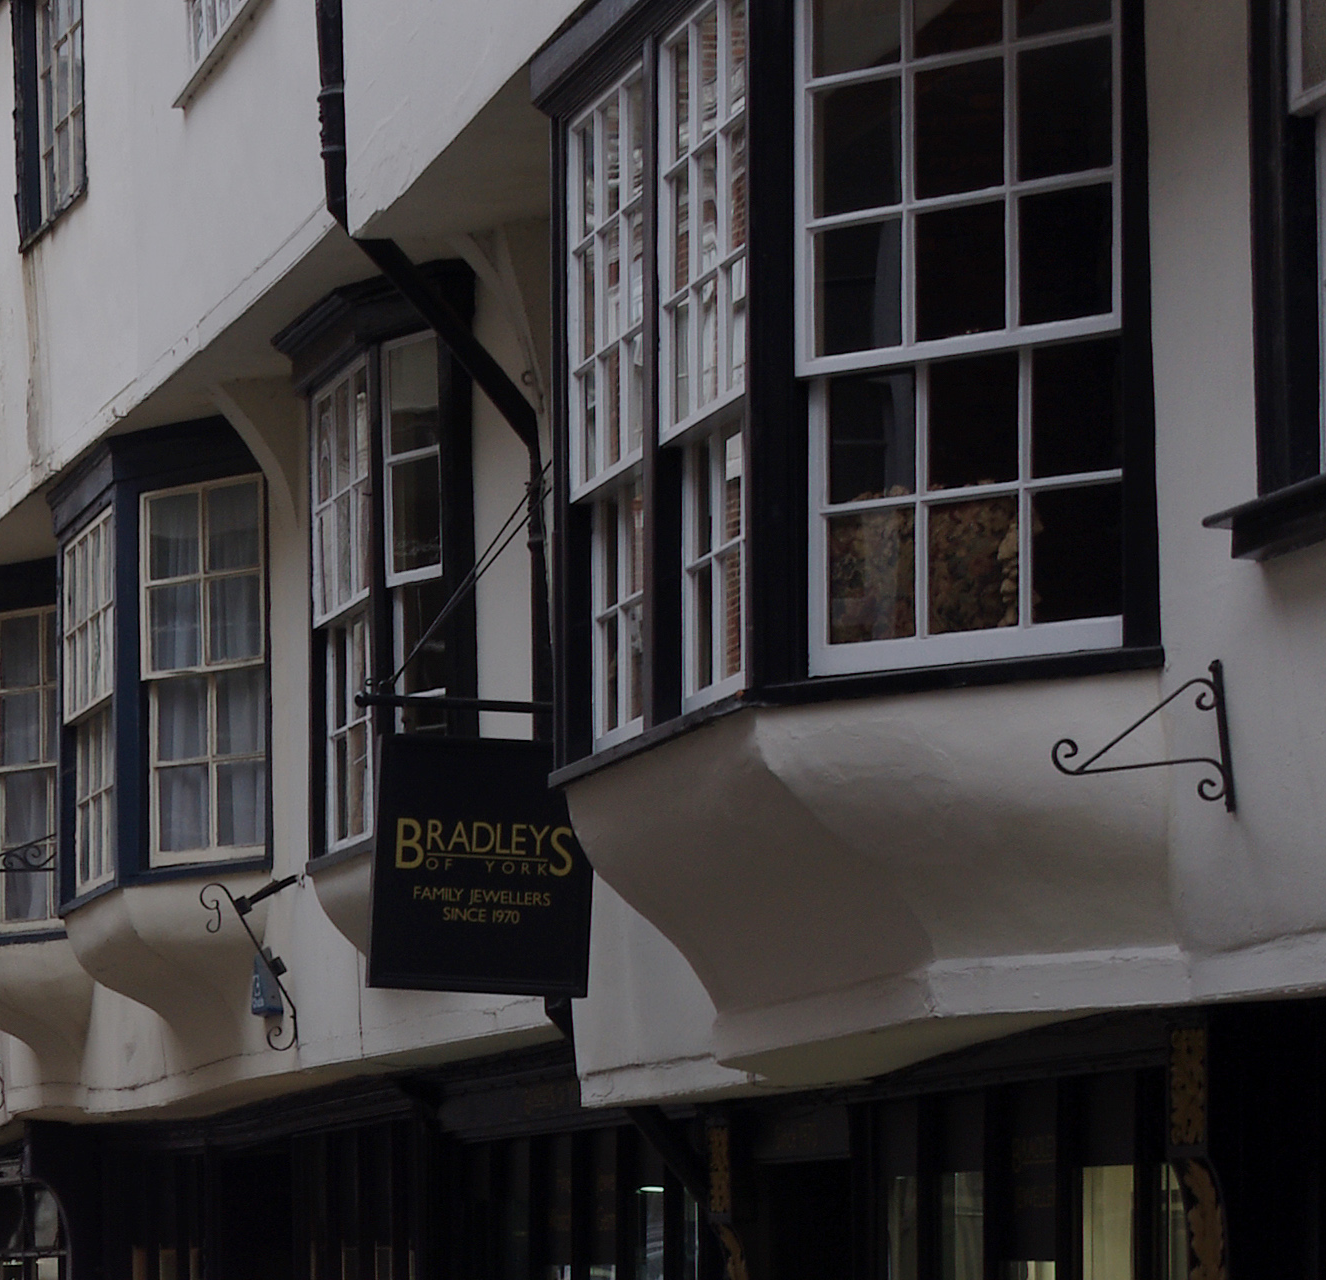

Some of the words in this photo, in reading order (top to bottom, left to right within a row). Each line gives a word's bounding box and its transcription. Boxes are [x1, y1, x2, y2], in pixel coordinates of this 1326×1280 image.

[395, 817, 573, 877] BRADLEYS
[426, 858, 454, 871] OF
[485, 860, 548, 876] YORK
[413, 886, 464, 901] FAMILY
[469, 888, 552, 907] JEWELLERS
[442, 906, 487, 922] SINCE
[492, 909, 521, 925] 1970
